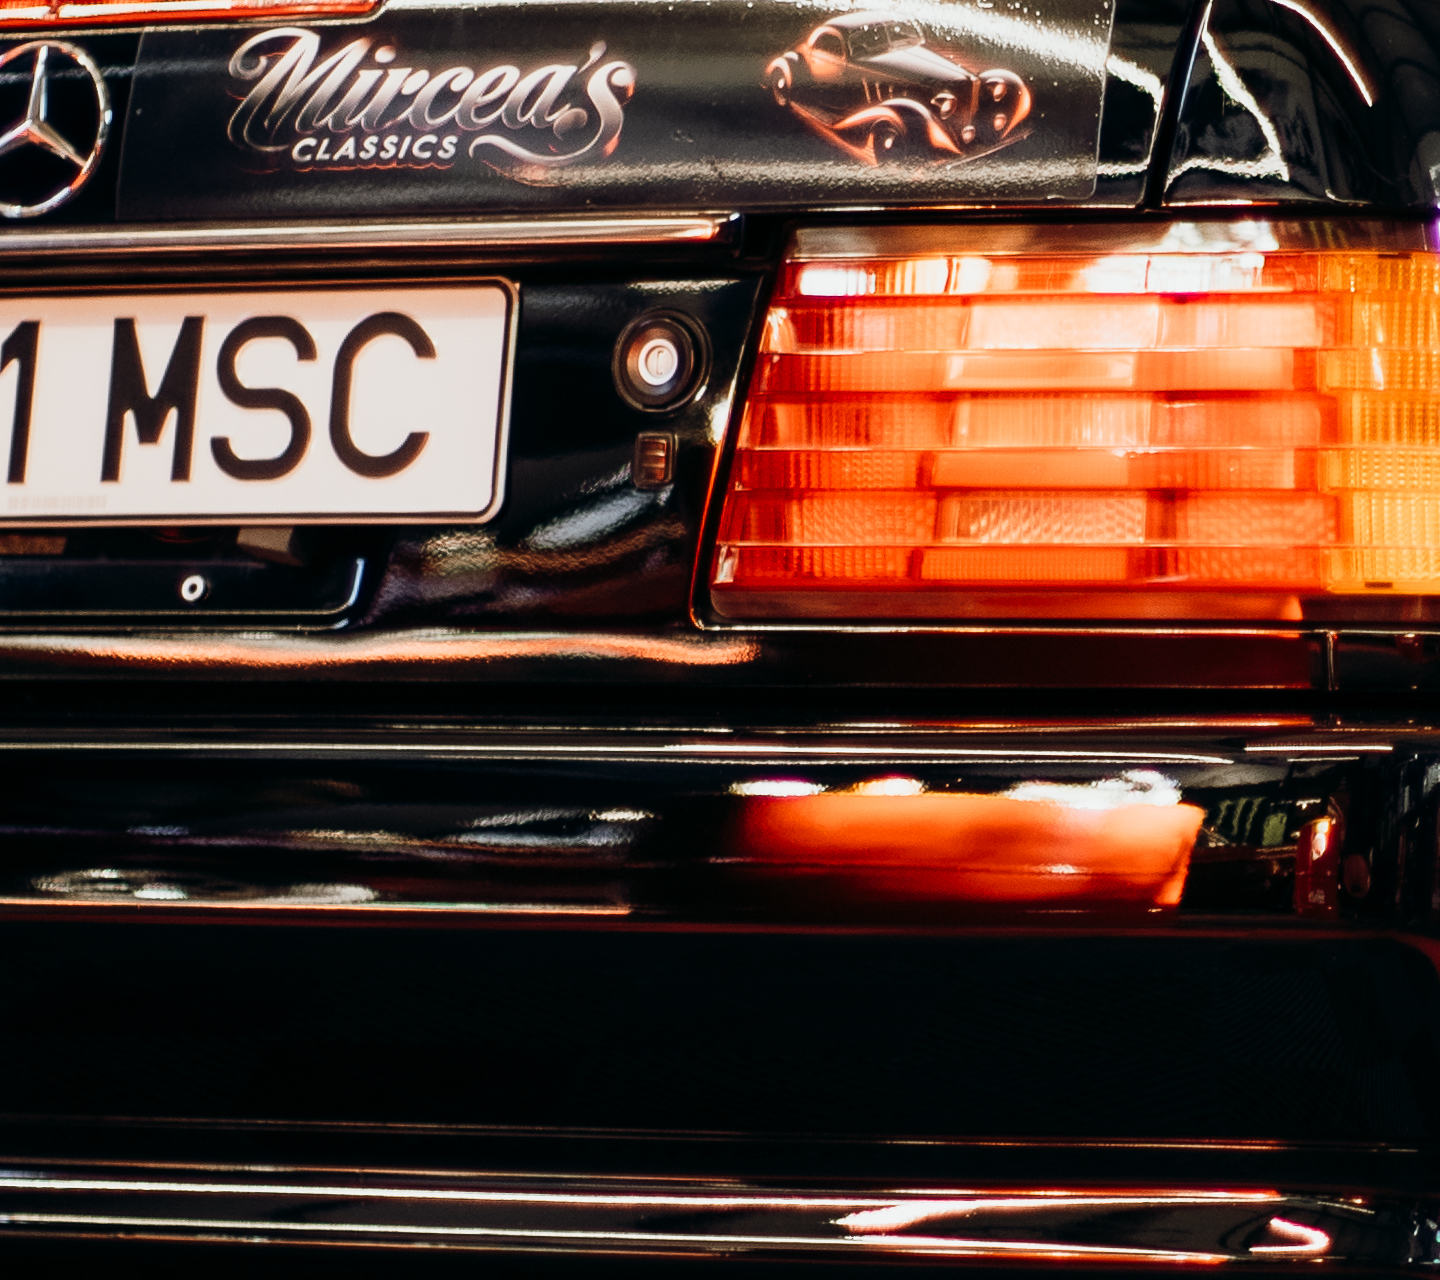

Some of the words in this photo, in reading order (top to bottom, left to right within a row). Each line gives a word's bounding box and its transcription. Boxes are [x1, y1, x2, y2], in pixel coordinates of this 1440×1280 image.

[227, 27, 636, 163] Mircea's
[292, 134, 458, 163] CLASSICS
[101, 312, 437, 483] MSC
